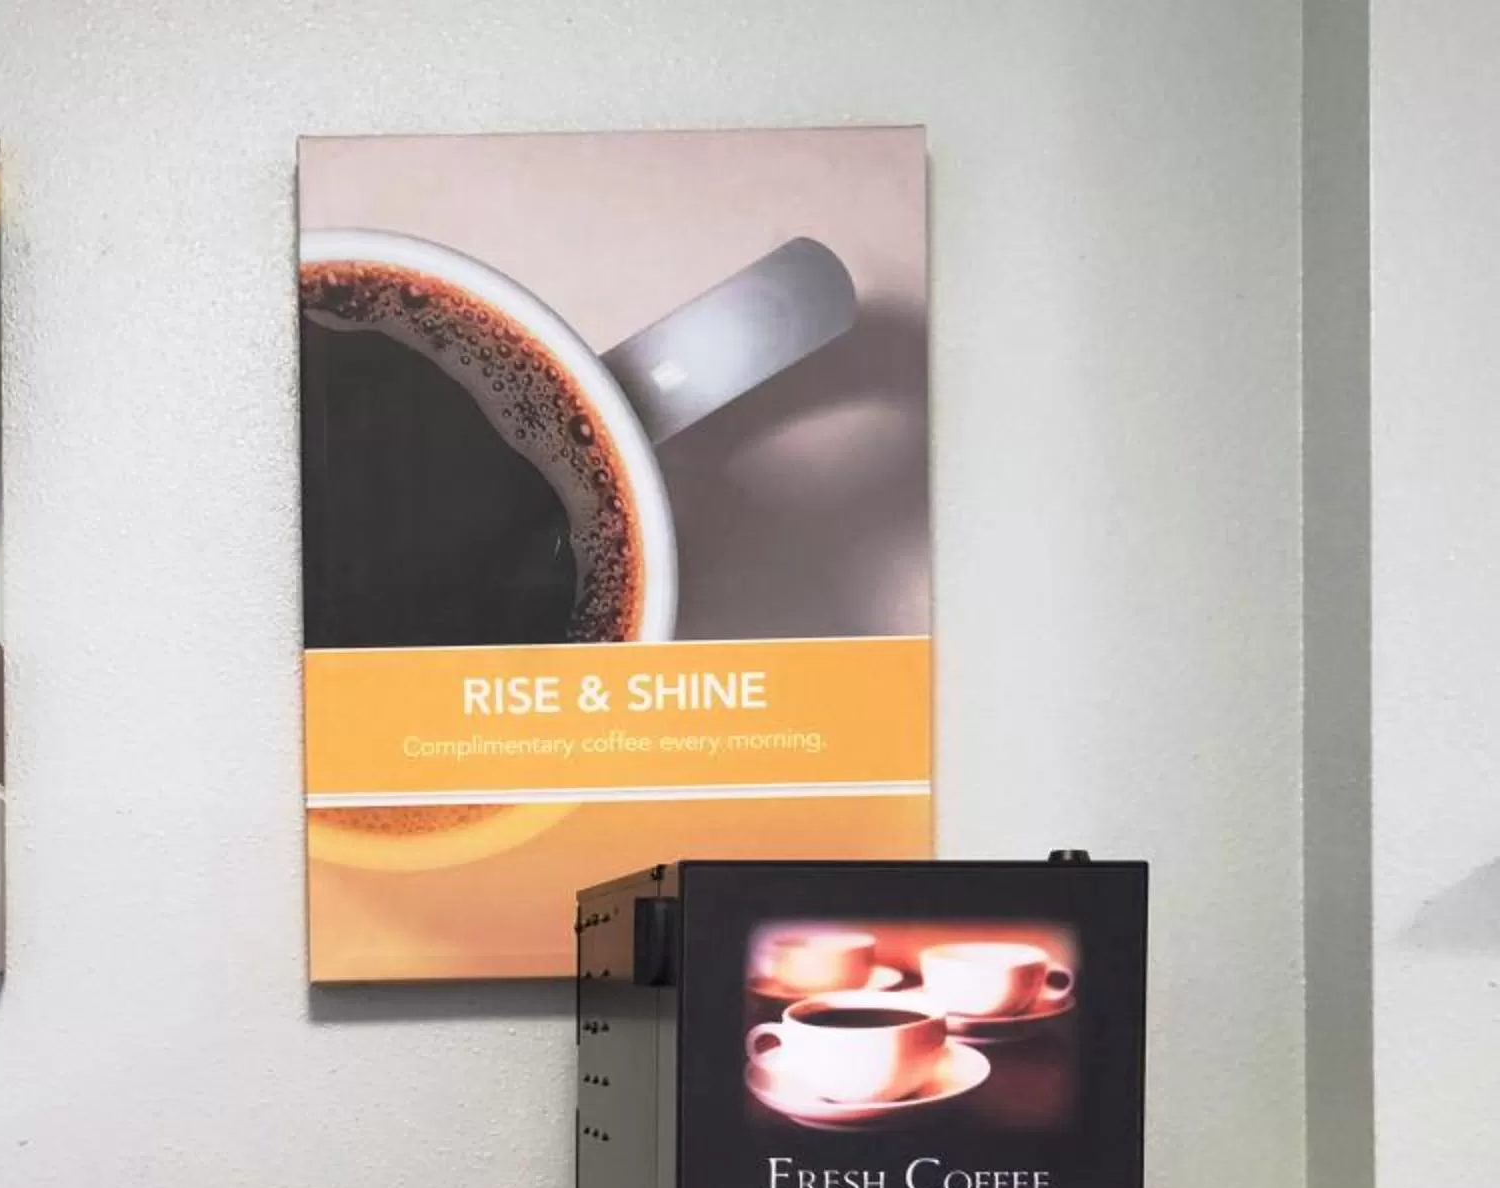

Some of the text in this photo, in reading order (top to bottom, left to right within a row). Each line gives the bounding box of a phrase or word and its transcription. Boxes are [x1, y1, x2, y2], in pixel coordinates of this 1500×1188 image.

[463, 671, 767, 716] RISE & SHINE
[403, 728, 828, 760] Complimentary coffee every morning.
